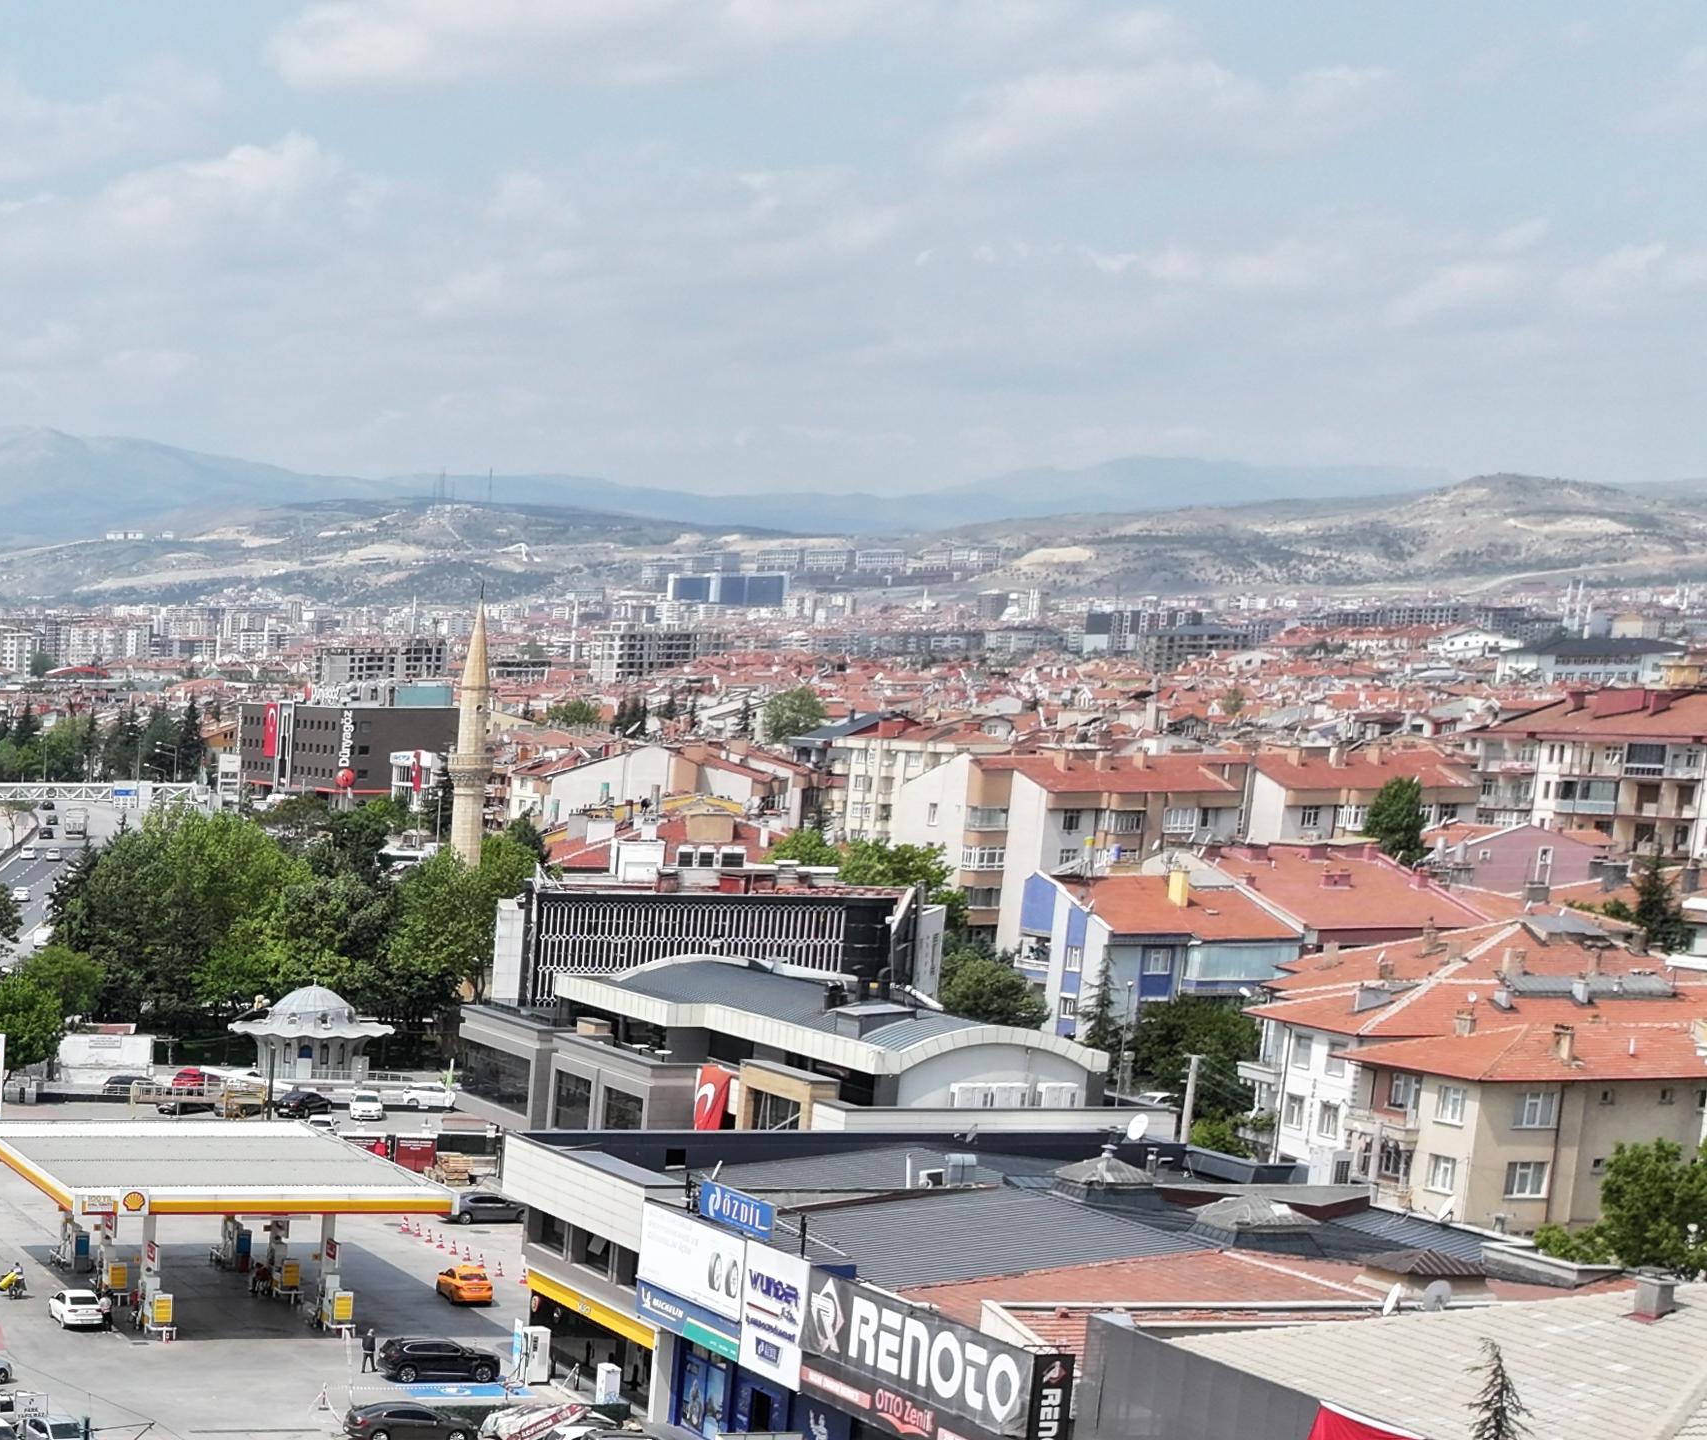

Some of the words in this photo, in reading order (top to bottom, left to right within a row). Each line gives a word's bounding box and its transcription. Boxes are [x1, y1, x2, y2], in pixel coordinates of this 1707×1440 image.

[339, 710, 354, 767] Dünyagöz
[721, 1190, 771, 1231] ÖZDİL
[848, 1295, 1021, 1424] RENOTO
[874, 1387, 903, 1417] OTTO
